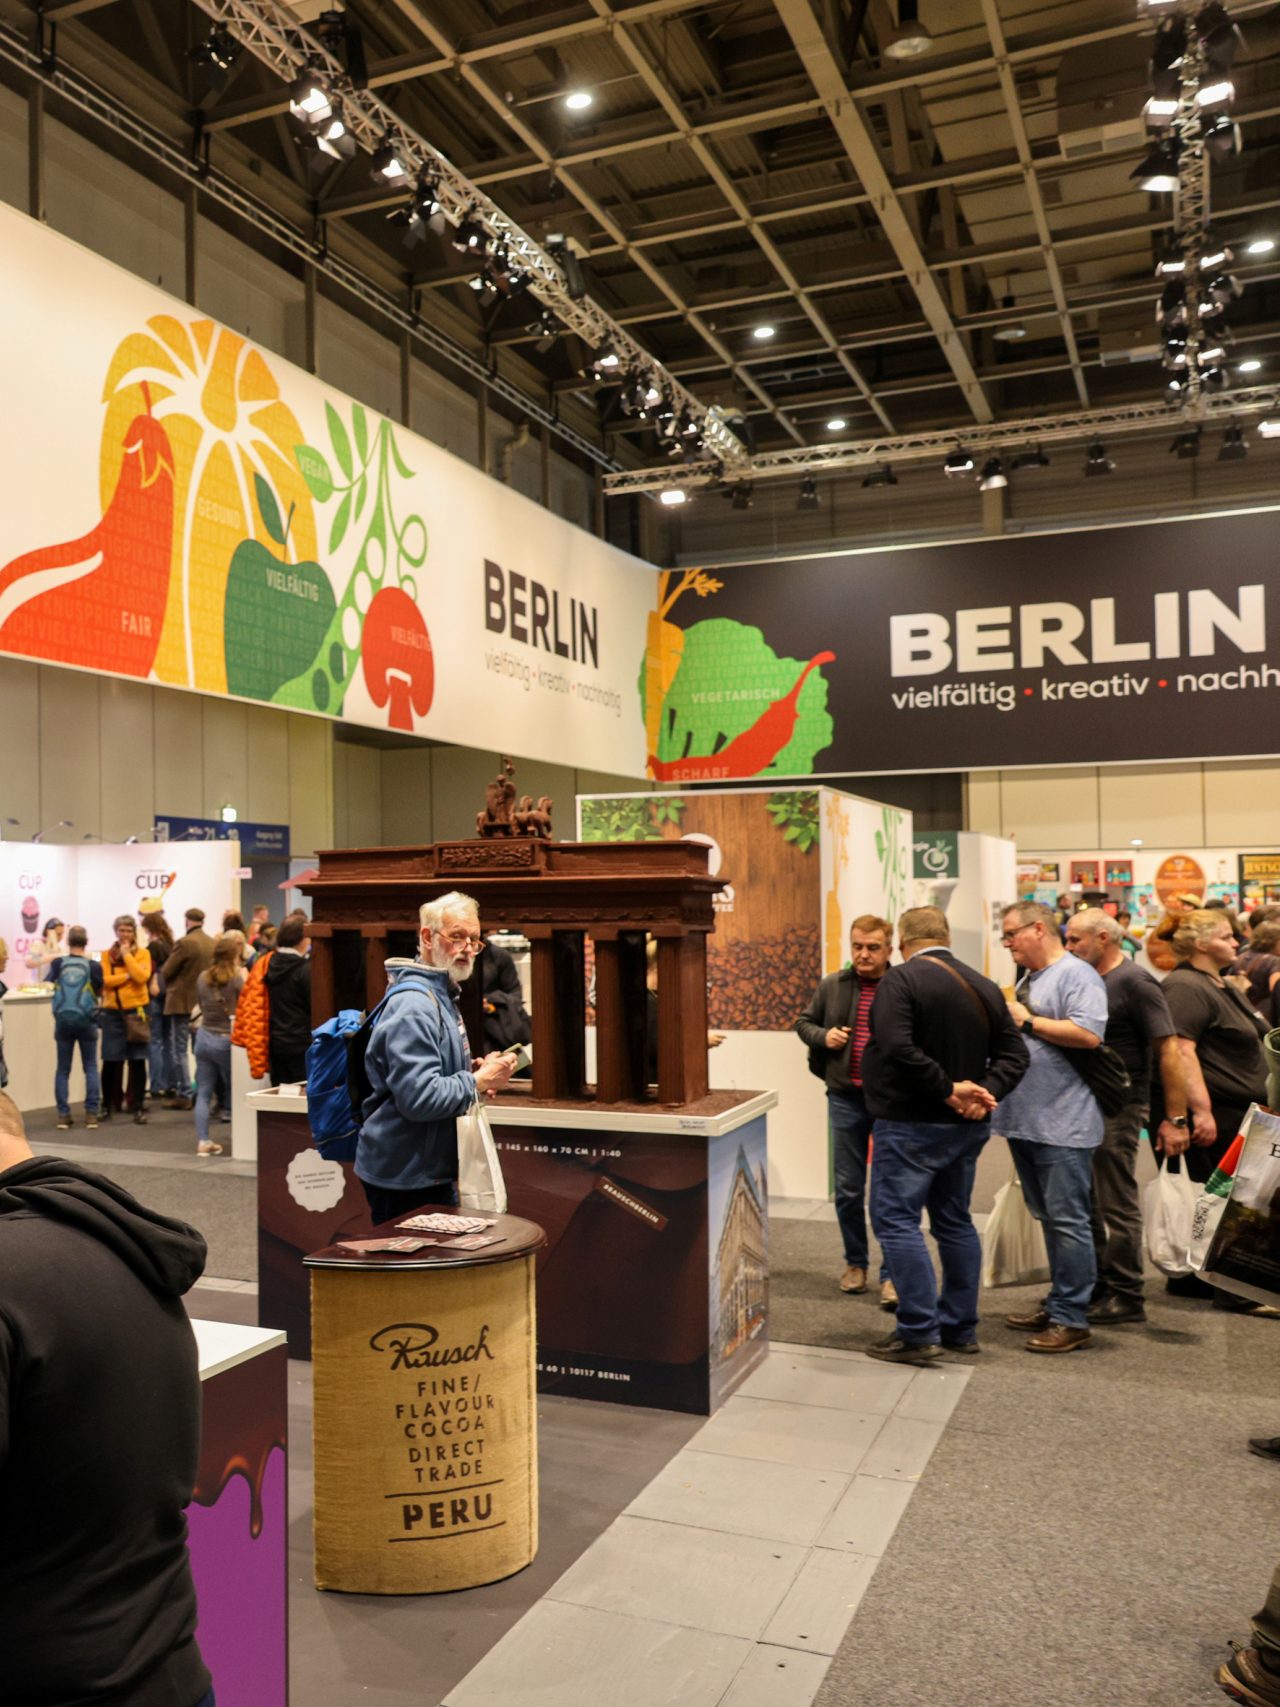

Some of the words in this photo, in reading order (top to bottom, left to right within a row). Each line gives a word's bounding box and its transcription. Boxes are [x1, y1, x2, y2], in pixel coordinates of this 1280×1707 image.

[197, 496, 241, 530] GESUND
[265, 567, 319, 603] VIELFÄLTIG
[121, 610, 153, 638] FAIR
[483, 557, 599, 670] BERLIN
[890, 584, 1266, 677] BERLIN
[691, 687, 781, 704] VEGETARISCH
[891, 682, 1016, 712] vielfältig
[1041, 672, 1150, 700] kreativ
[671, 766, 730, 781] SCHARF
[19, 873, 43, 890] CUP
[135, 873, 170, 890] CUP
[505, 1142, 521, 1152] 145
[560, 1146, 572, 1155] 70
[369, 1322, 495, 1371] Rausch
[417, 1373, 481, 1397] FINE/
[597, 1370, 631, 1382] BERLIN
[395, 1394, 495, 1420] FLAVOUR
[404, 1415, 486, 1439] COCOA
[408, 1439, 485, 1464] DIRECT
[414, 1459, 484, 1484] TRADE
[402, 1493, 492, 1531] PERU
